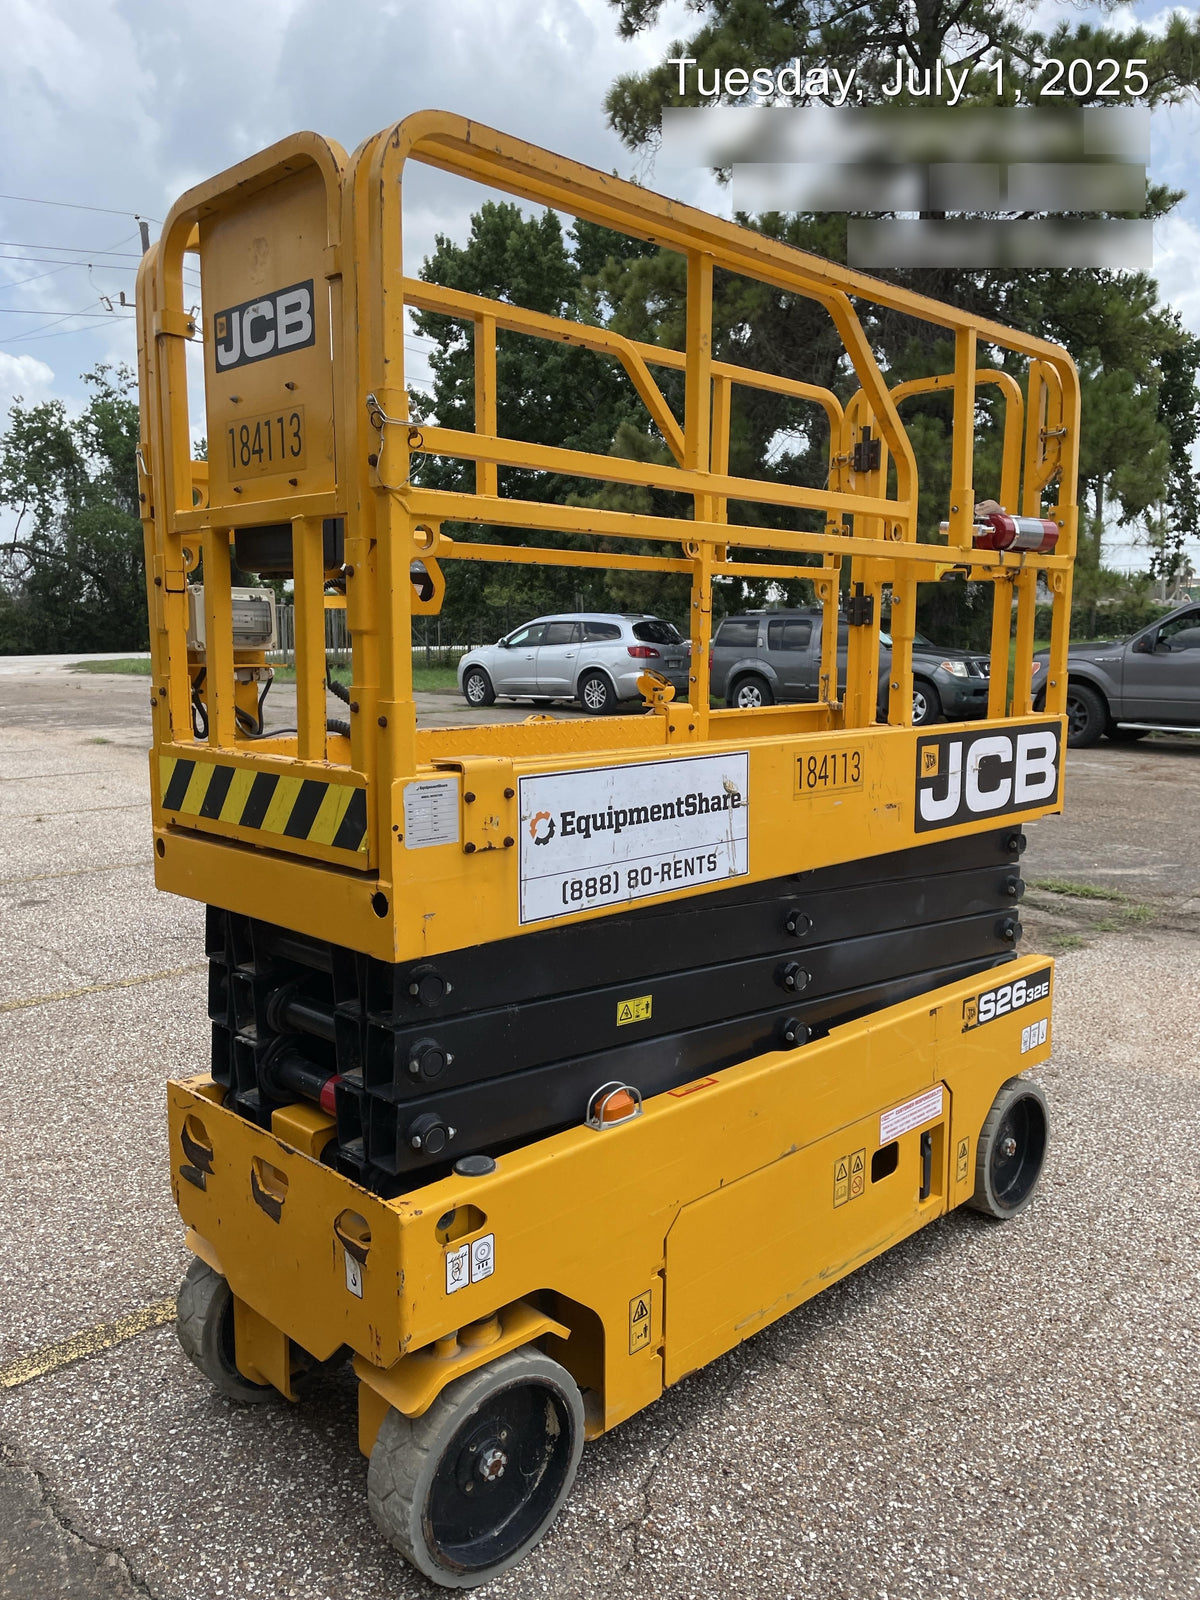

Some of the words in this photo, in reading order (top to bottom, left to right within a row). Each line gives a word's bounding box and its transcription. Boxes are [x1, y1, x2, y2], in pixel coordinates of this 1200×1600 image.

[217, 288, 312, 366] JCB
[228, 412, 302, 468] 184113
[796, 751, 861, 790] 184113
[920, 731, 1057, 822] JCB
[560, 791, 742, 839] EquipmentShare
[562, 871, 620, 905] (888)
[627, 853, 718, 889] 80-RENTS
